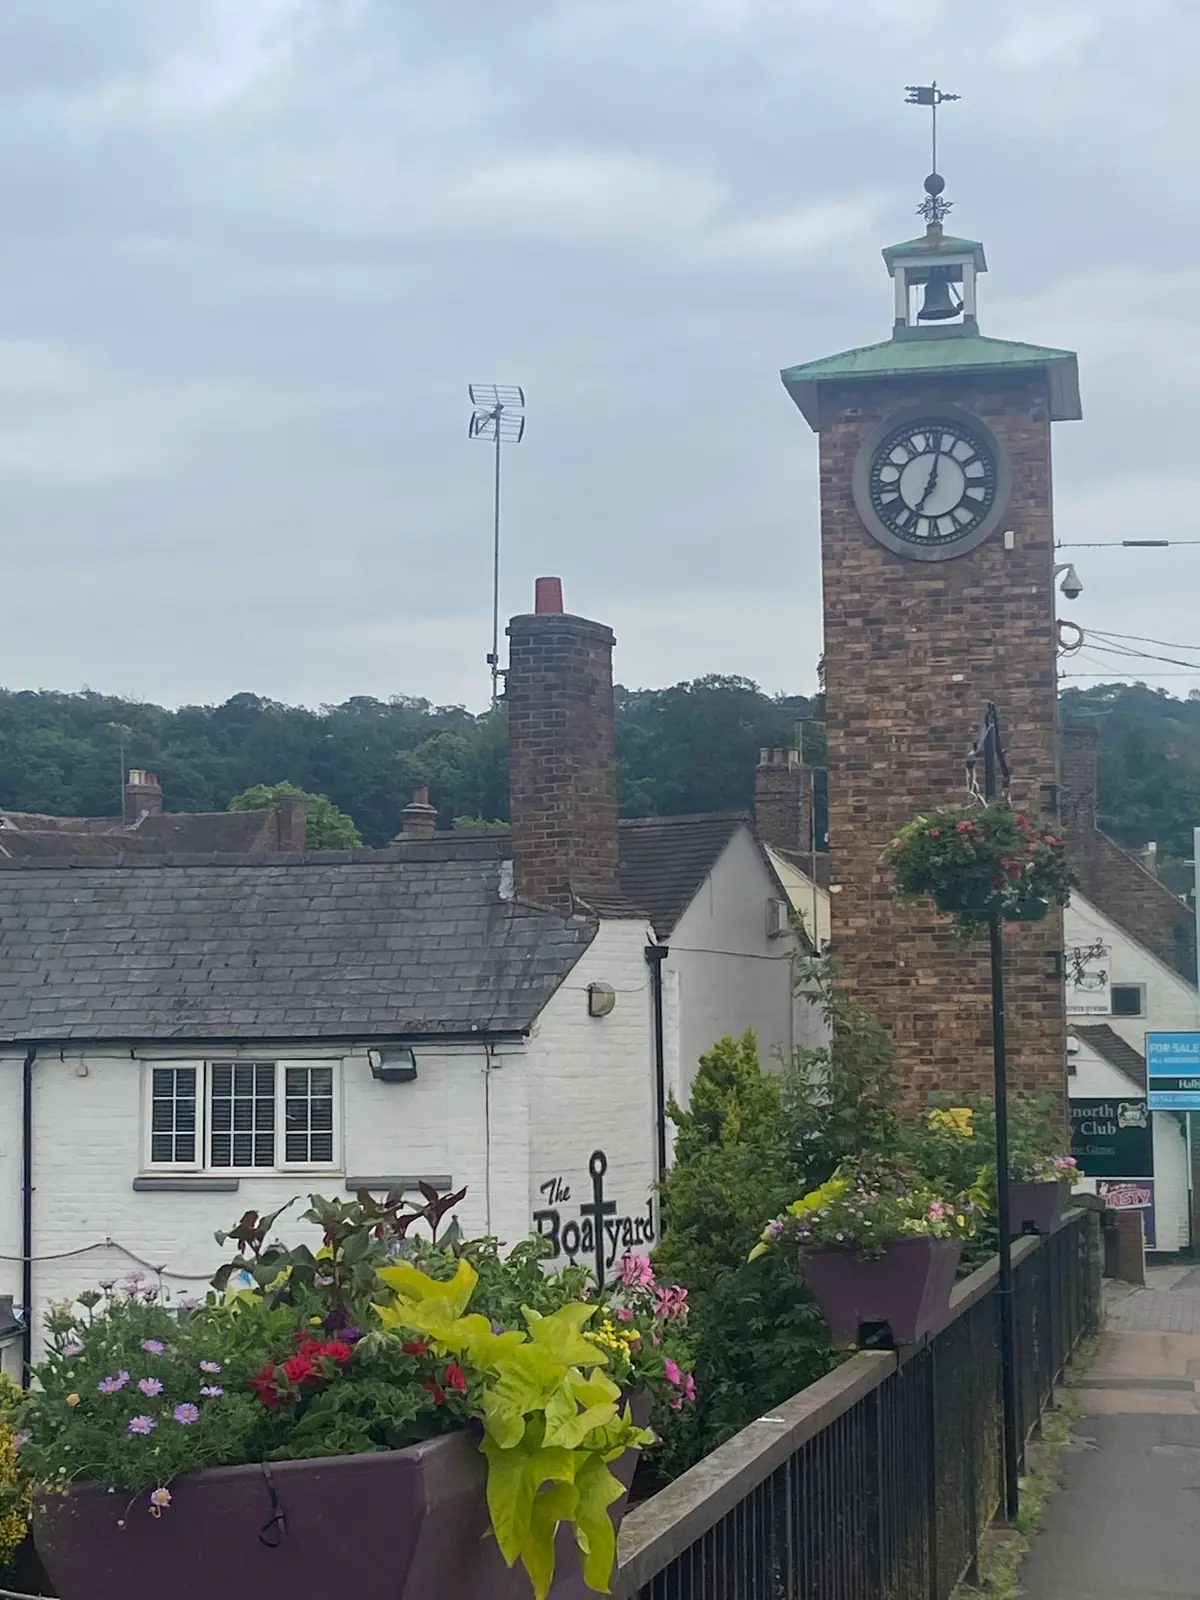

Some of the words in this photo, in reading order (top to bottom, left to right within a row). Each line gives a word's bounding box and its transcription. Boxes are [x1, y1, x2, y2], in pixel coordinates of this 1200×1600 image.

[1150, 1043, 1170, 1053] FOR
[1172, 1043, 1199, 1053] SALE
[1080, 1121, 1116, 1136] Club
[540, 1176, 571, 1205] The
[533, 1194, 655, 1272] Boatyard
